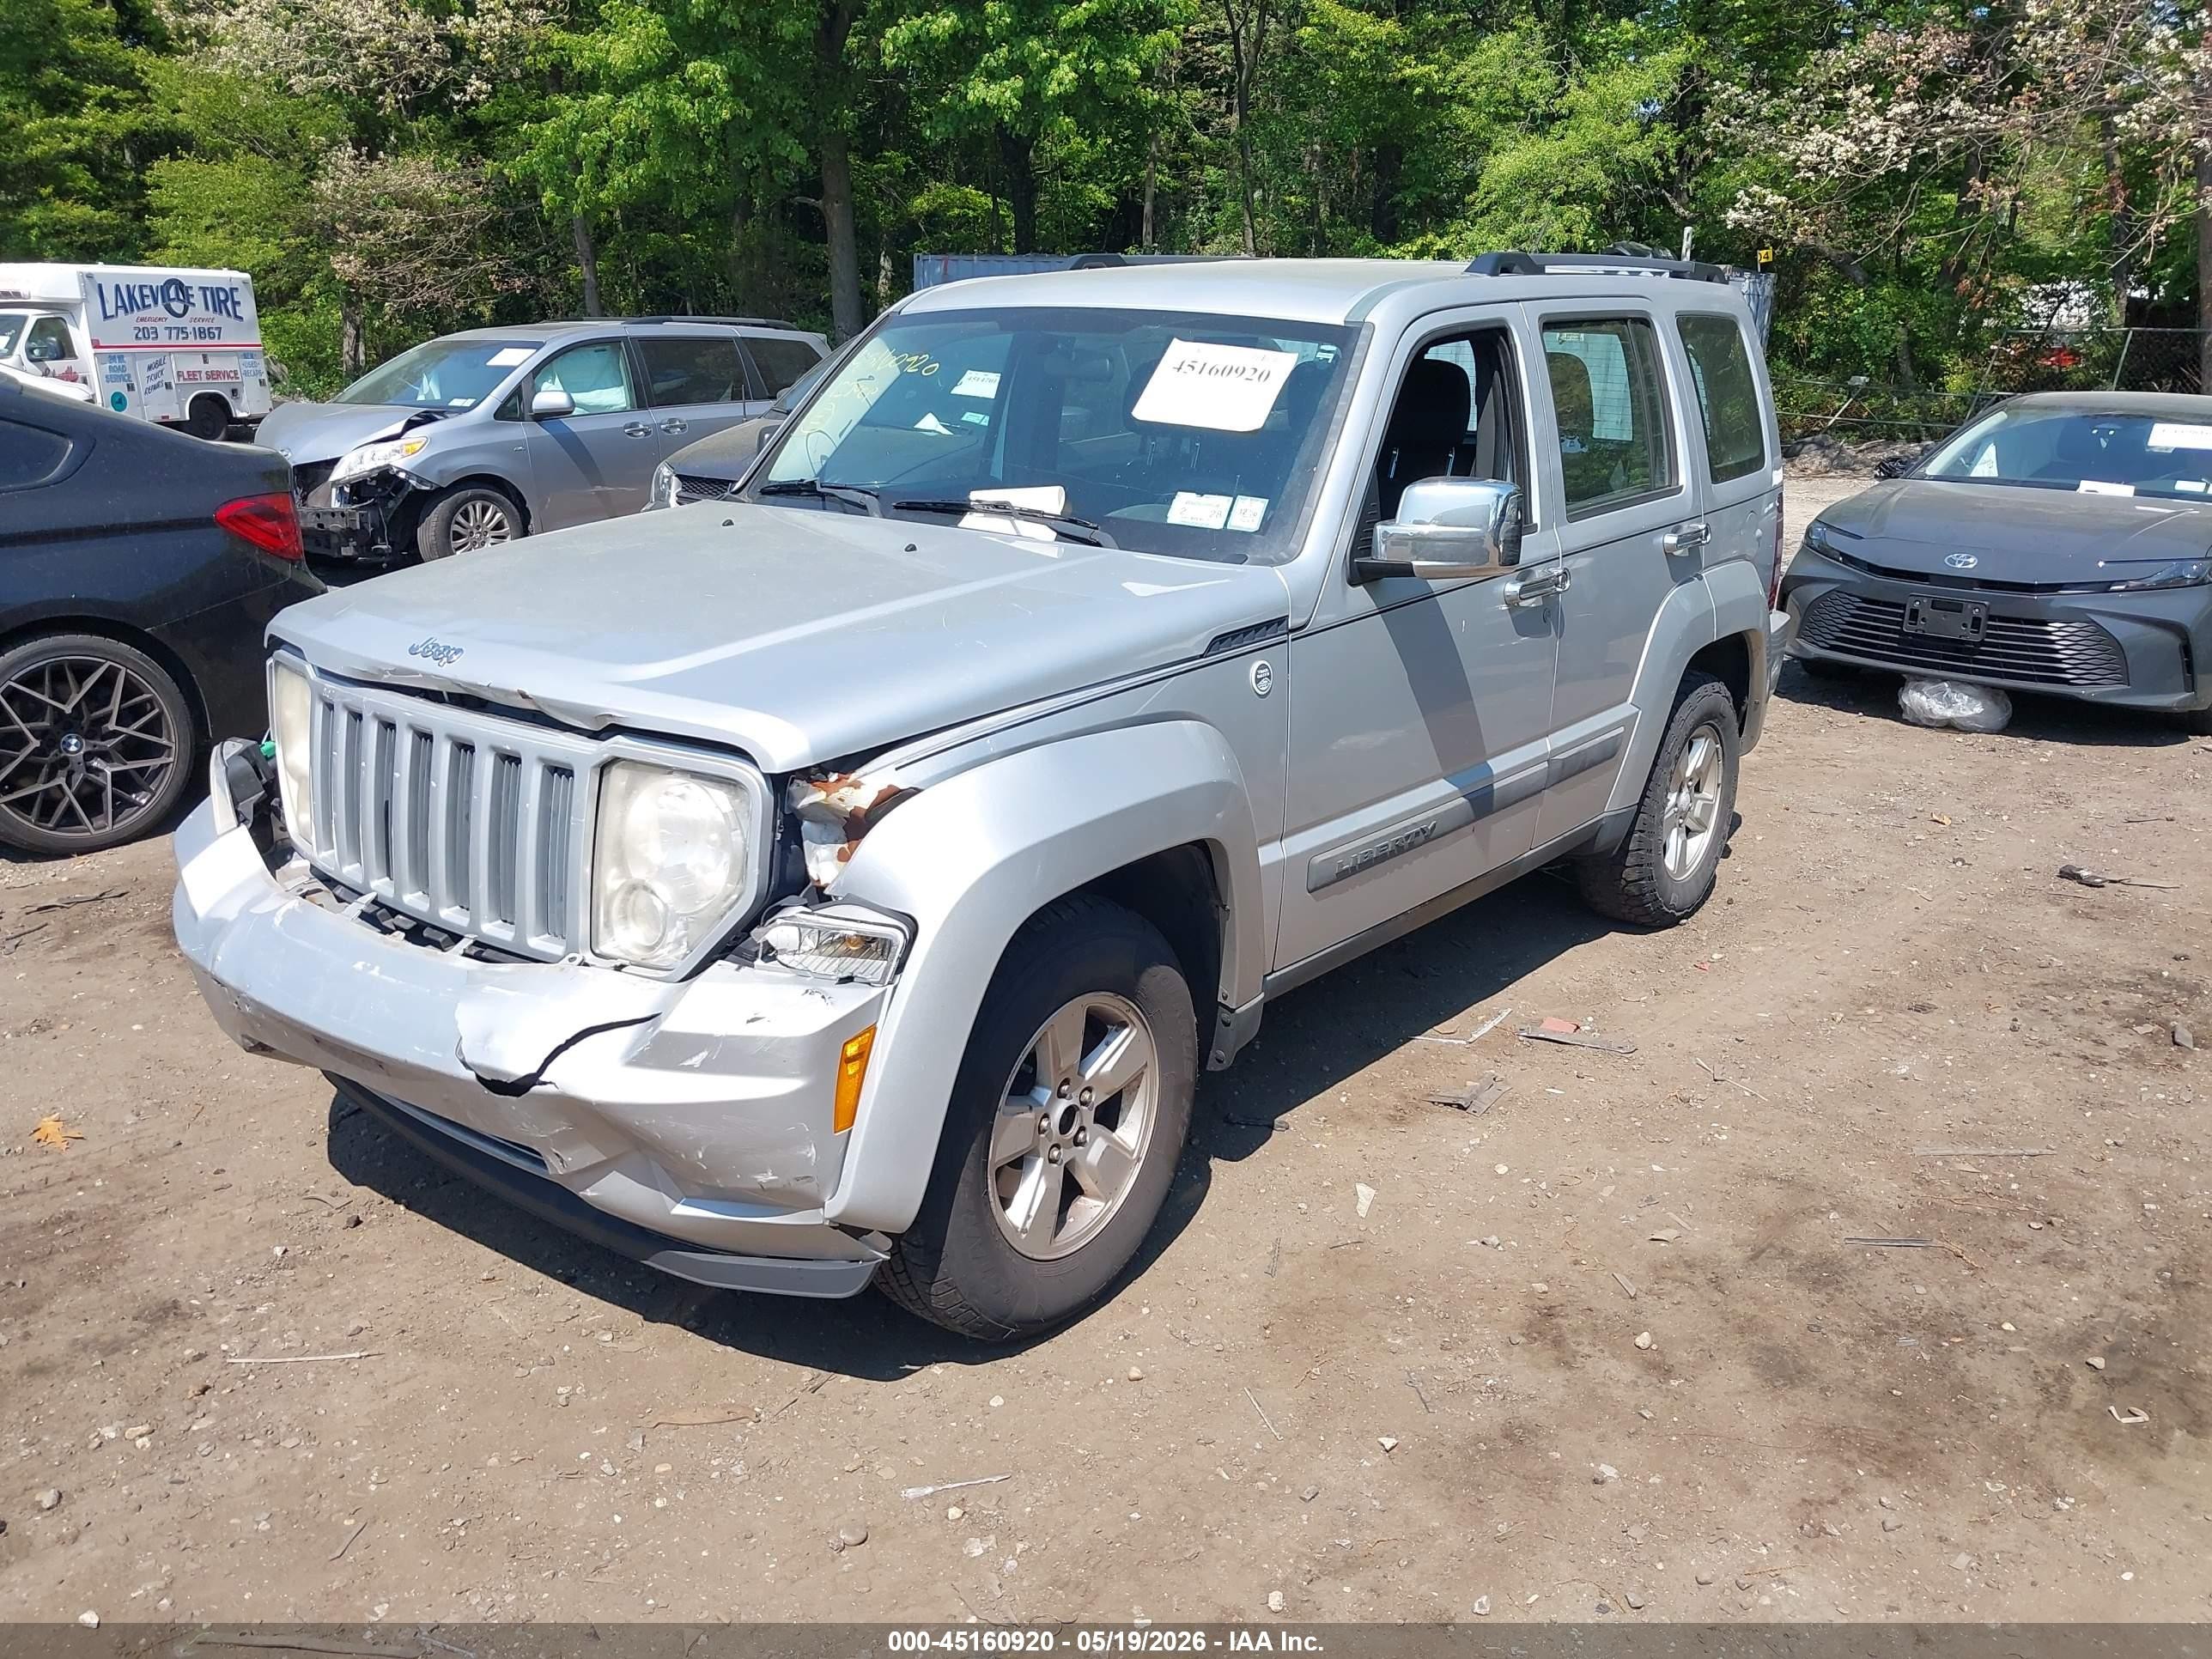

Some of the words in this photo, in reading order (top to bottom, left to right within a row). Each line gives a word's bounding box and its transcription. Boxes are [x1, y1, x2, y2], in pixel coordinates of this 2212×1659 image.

[98, 283, 196, 321] LAKEVILLE
[198, 286, 244, 322] TIRE
[133, 326, 159, 340] 203
[147, 356, 167, 373] MOBILE
[1172, 359, 1272, 383] 45160920
[146, 368, 164, 384] TRUCK
[177, 370, 203, 382] FLEET
[205, 369, 240, 381] SERVICE
[408, 637, 465, 667] Jeep
[1334, 820, 1437, 877] LIBERTY
